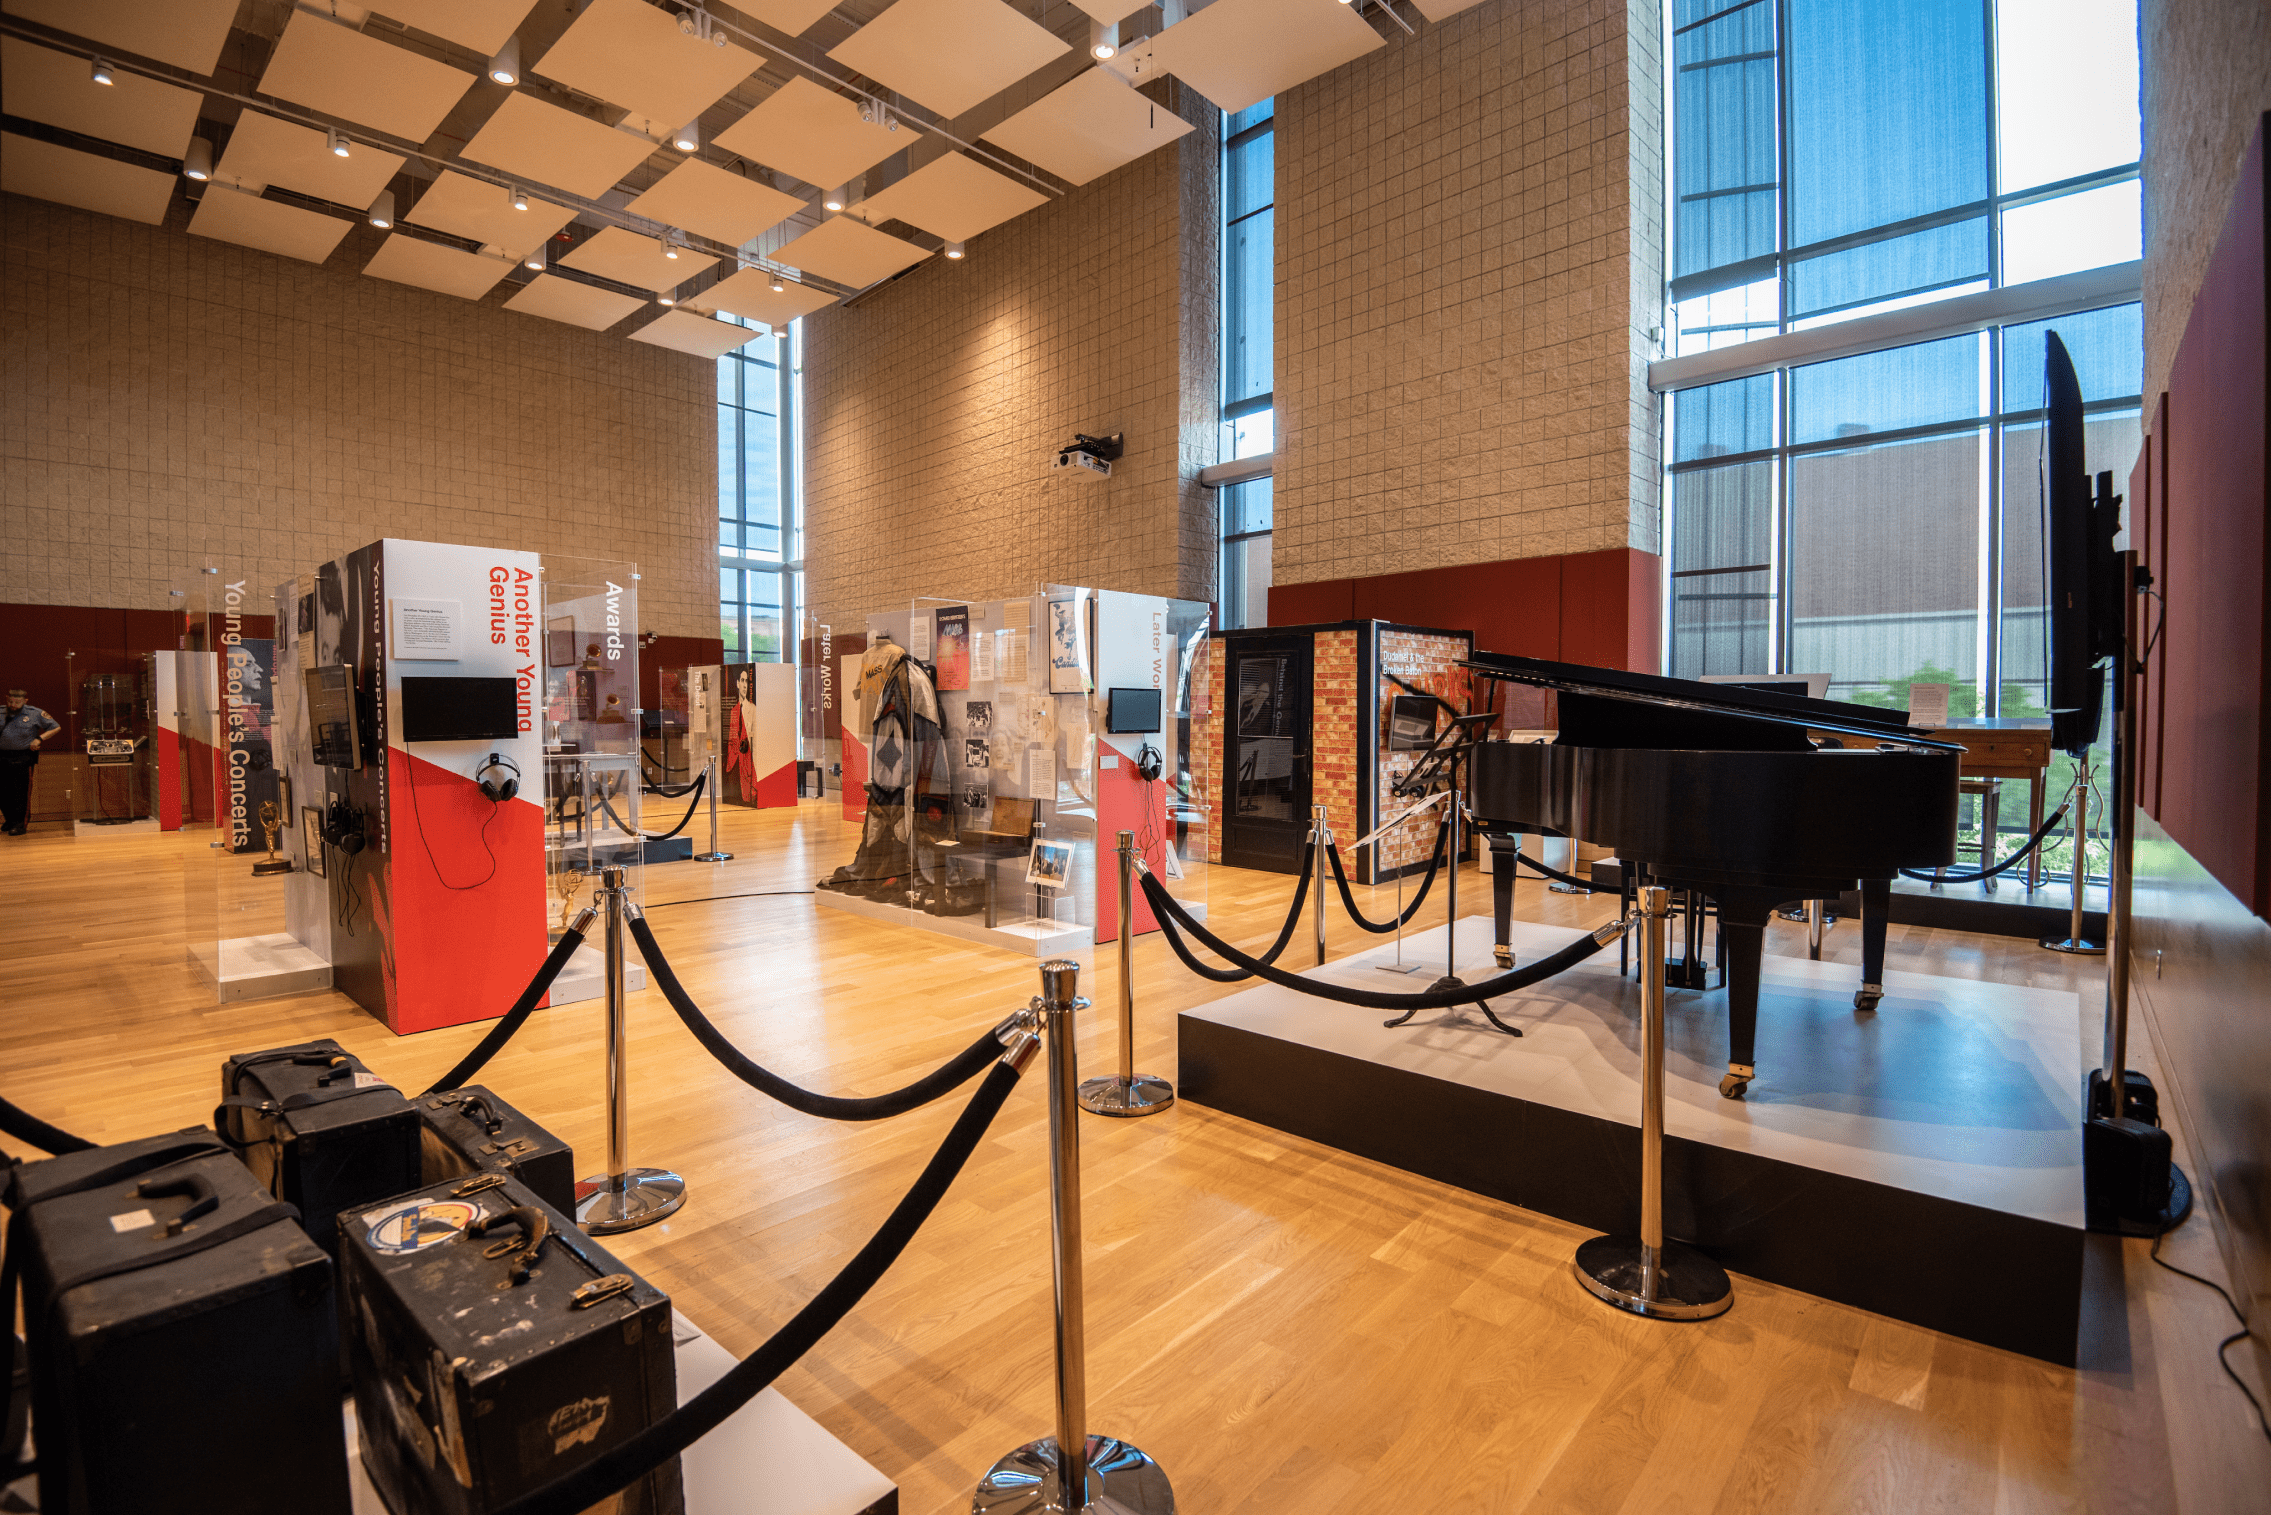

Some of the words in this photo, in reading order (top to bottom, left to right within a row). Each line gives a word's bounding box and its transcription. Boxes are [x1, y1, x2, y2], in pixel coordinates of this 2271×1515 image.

[220, 580, 246, 645] Young
[489, 566, 510, 644] Genius
[514, 567, 535, 658] Another
[605, 580, 625, 661] Awards
[1152, 612, 1162, 653] Later
[375, 642, 383, 740] People's
[865, 664, 883, 680] MASS
[1152, 658, 1162, 689] Wor
[1278, 658, 1287, 691] Behind
[1383, 664, 1404, 675] Broken
[1405, 665, 1422, 676] Baton
[1416, 654, 1424, 662] the
[223, 653, 250, 743] People's
[516, 664, 536, 732] Young
[229, 749, 251, 848] Concerts
[377, 747, 386, 854] Concerts
